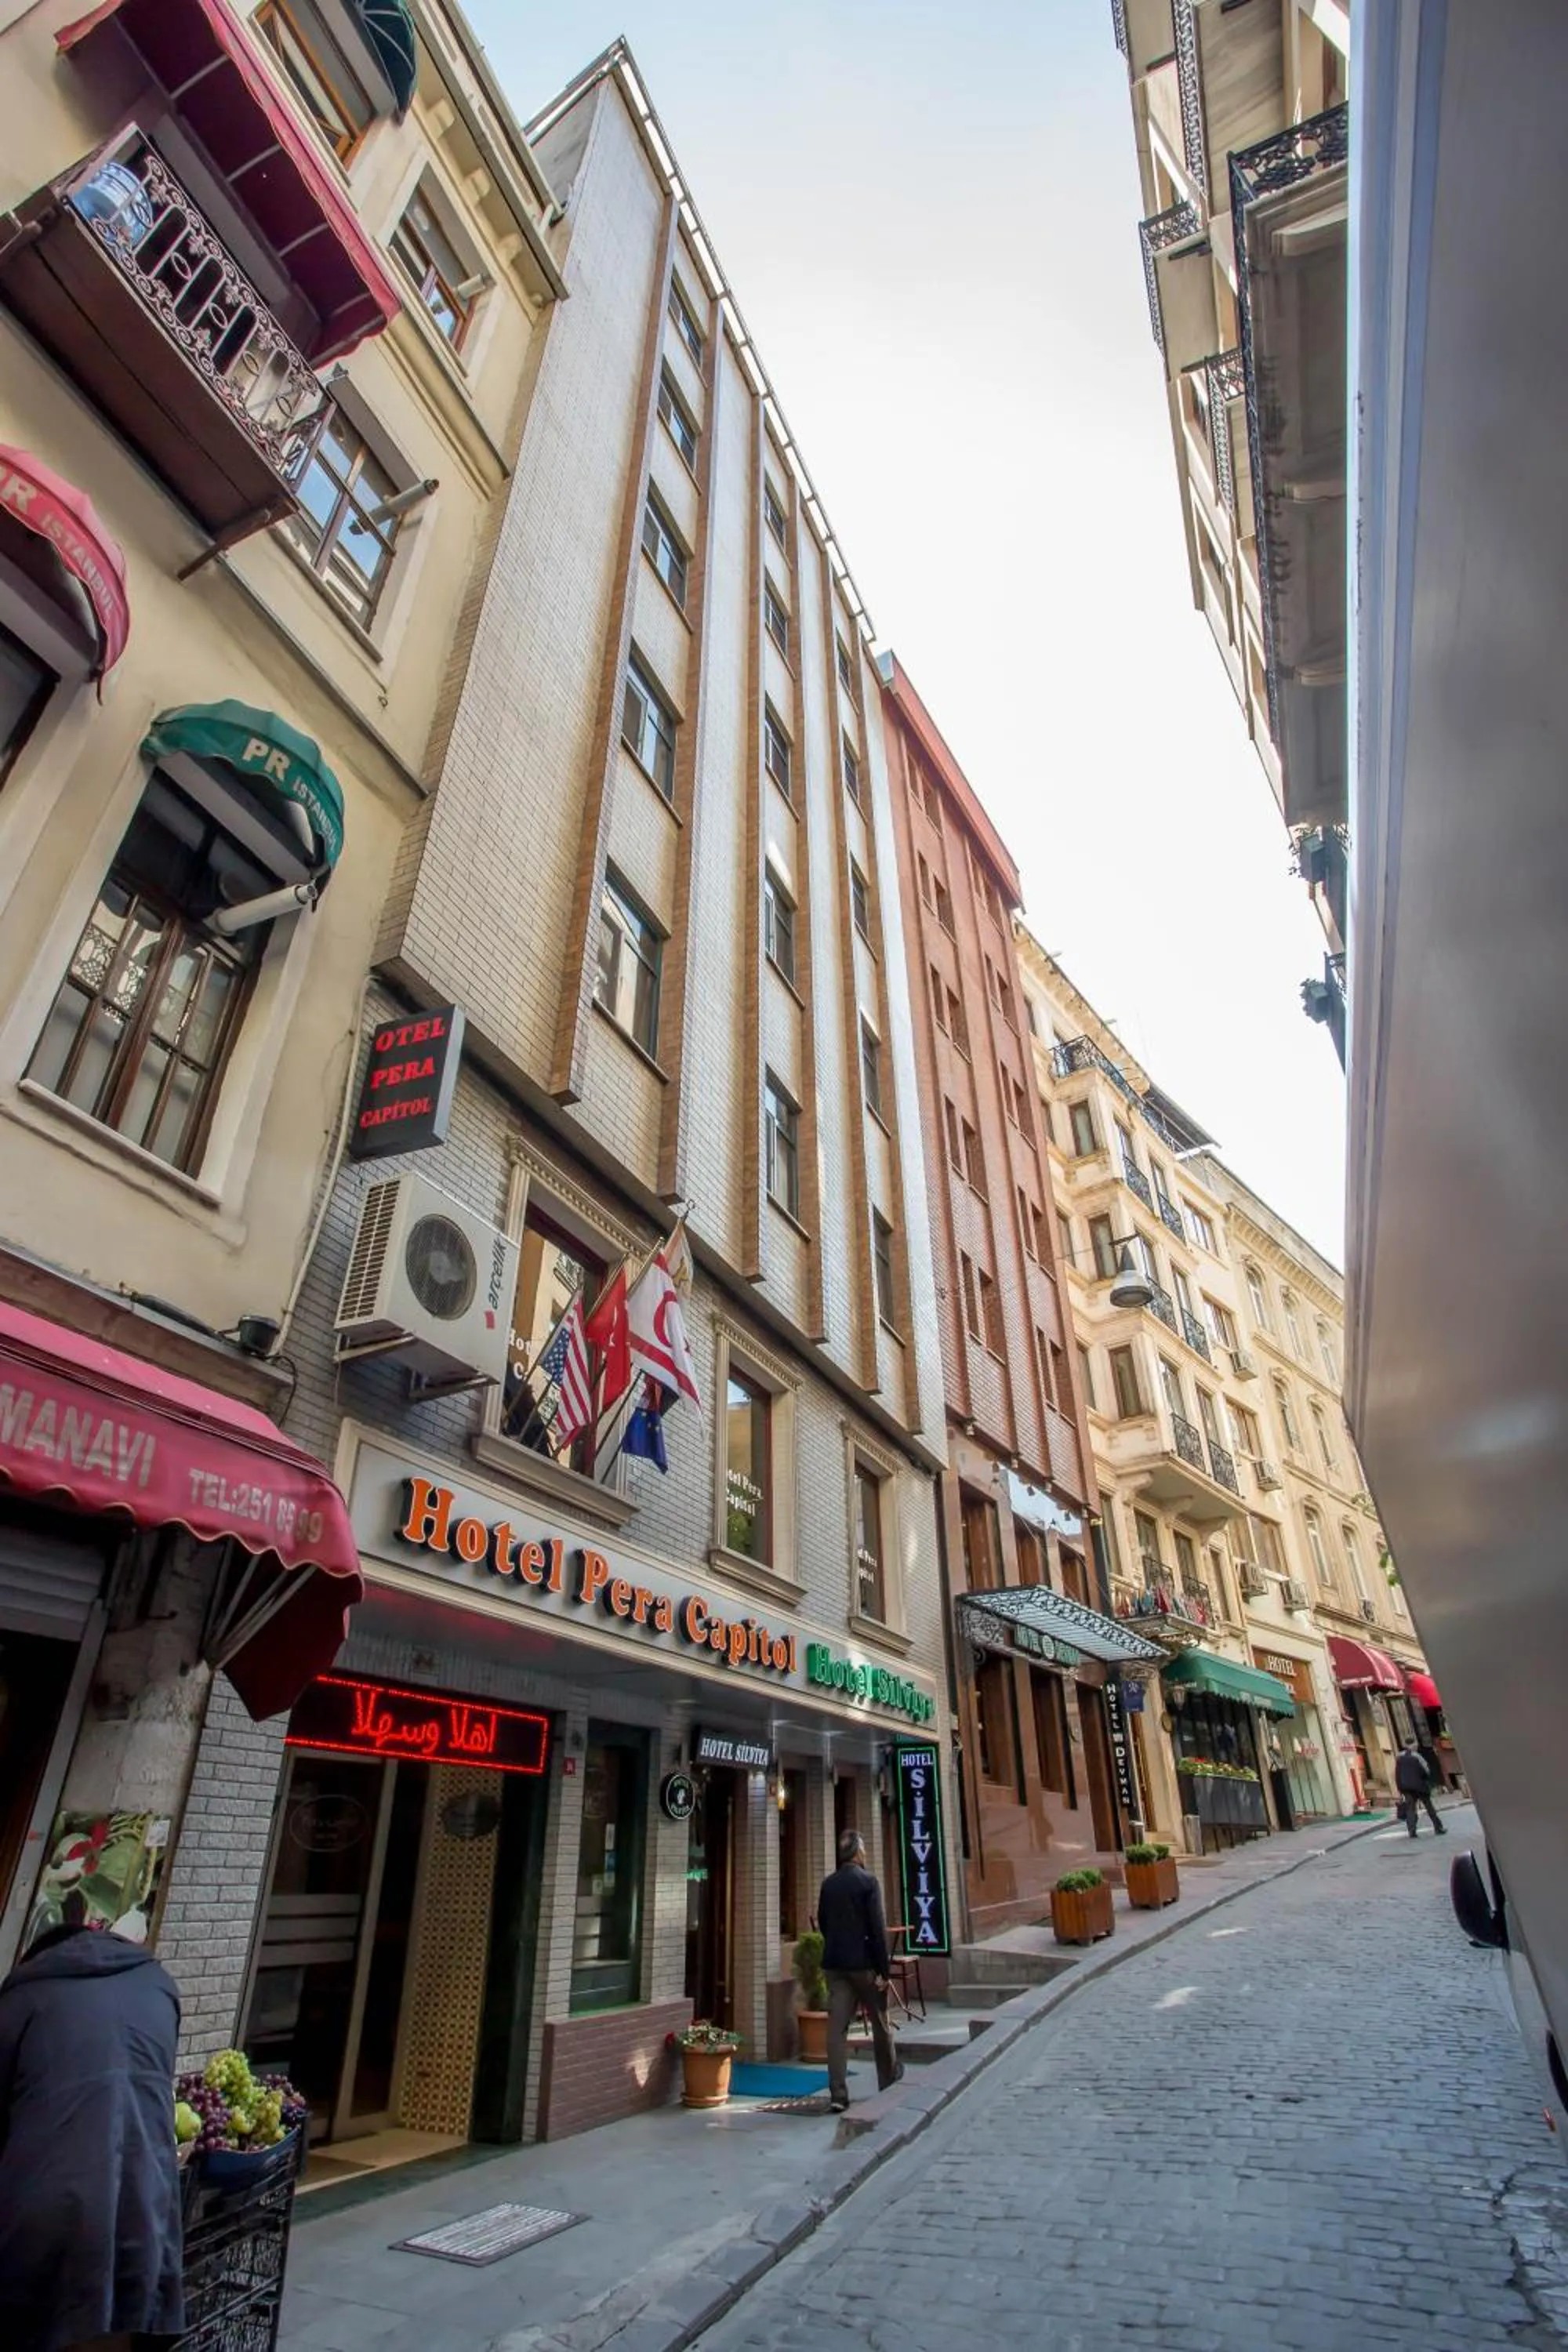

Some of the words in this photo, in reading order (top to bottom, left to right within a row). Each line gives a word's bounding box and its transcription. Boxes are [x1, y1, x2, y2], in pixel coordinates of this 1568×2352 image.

[0, 466, 38, 514] R
[242, 737, 291, 782] PR
[375, 1017, 446, 1052] OTEL
[370, 1056, 435, 1089] PERA
[488, 1234, 507, 1310] arçelik
[402, 1475, 564, 1593] Hotel
[579, 1548, 673, 1633] Pera
[685, 1594, 797, 1674] Capitol
[808, 1643, 873, 1699] Hotel
[350, 1690, 441, 1755] وسهلا
[448, 1707, 497, 1754] اهلا
[700, 1737, 733, 1760] HOTEL
[901, 1753, 934, 1767] HOTEL
